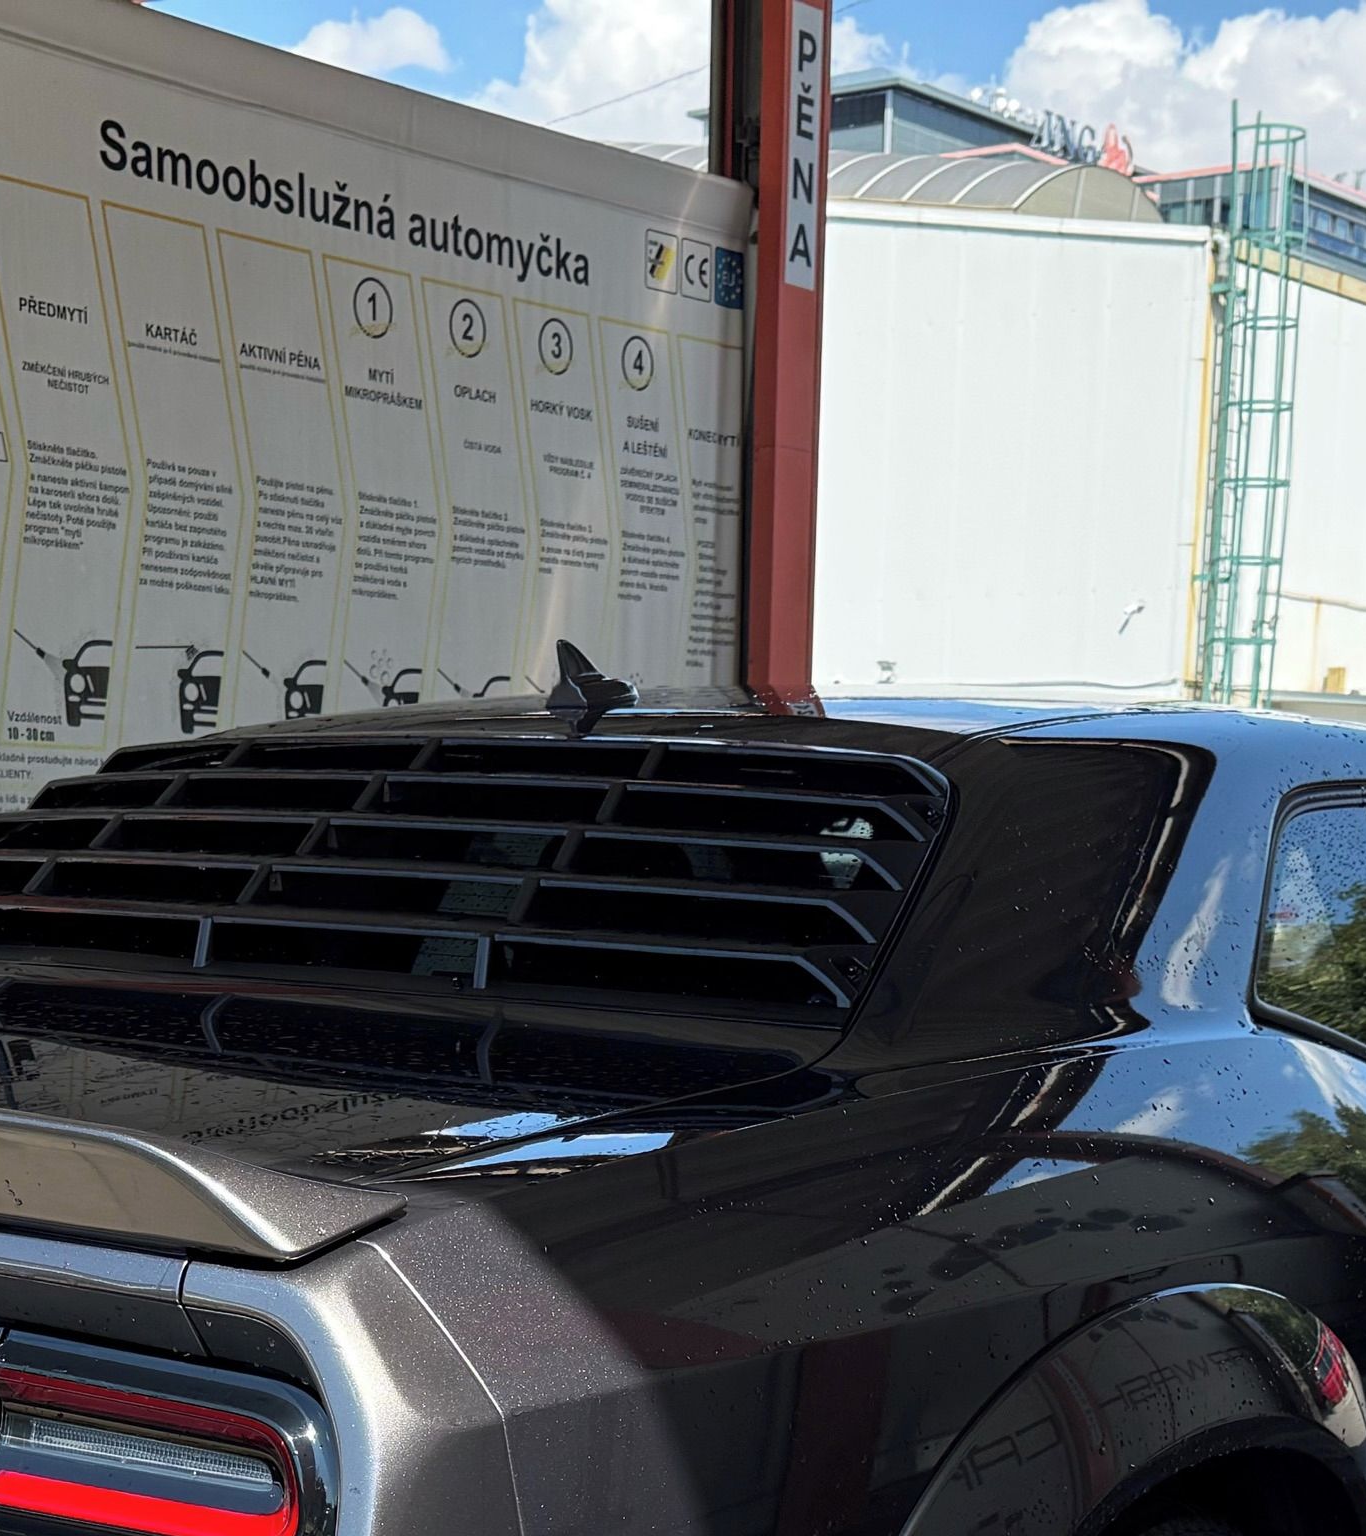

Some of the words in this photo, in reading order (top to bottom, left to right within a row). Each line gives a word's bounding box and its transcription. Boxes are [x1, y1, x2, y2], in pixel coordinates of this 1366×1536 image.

[789, 29, 817, 268] PĚNA
[98, 119, 397, 241] Samoobslužná
[407, 210, 591, 287] automyčka
[19, 295, 89, 325] PŘEDMYTÍ
[367, 292, 377, 321] 1
[145, 323, 198, 346] KARTÁČ
[461, 313, 475, 341] 2
[239, 343, 287, 365] AKTIVNÍ
[551, 332, 562, 359] 3
[633, 349, 645, 375] 4
[47, 377, 90, 395] NEČISTOT
[368, 367, 394, 385] MYTÍ
[344, 385, 423, 411] MIKROPRÁŠKEM
[453, 384, 497, 404] OPLACH
[530, 399, 565, 417] HORKÝ
[566, 405, 593, 422] VOSK
[626, 414, 660, 433] SUŠENÍ
[7, 710, 62, 726] Vzdálenost
[7, 727, 20, 741] 10
[26, 728, 38, 741] 30
[39, 731, 56, 742] cm
